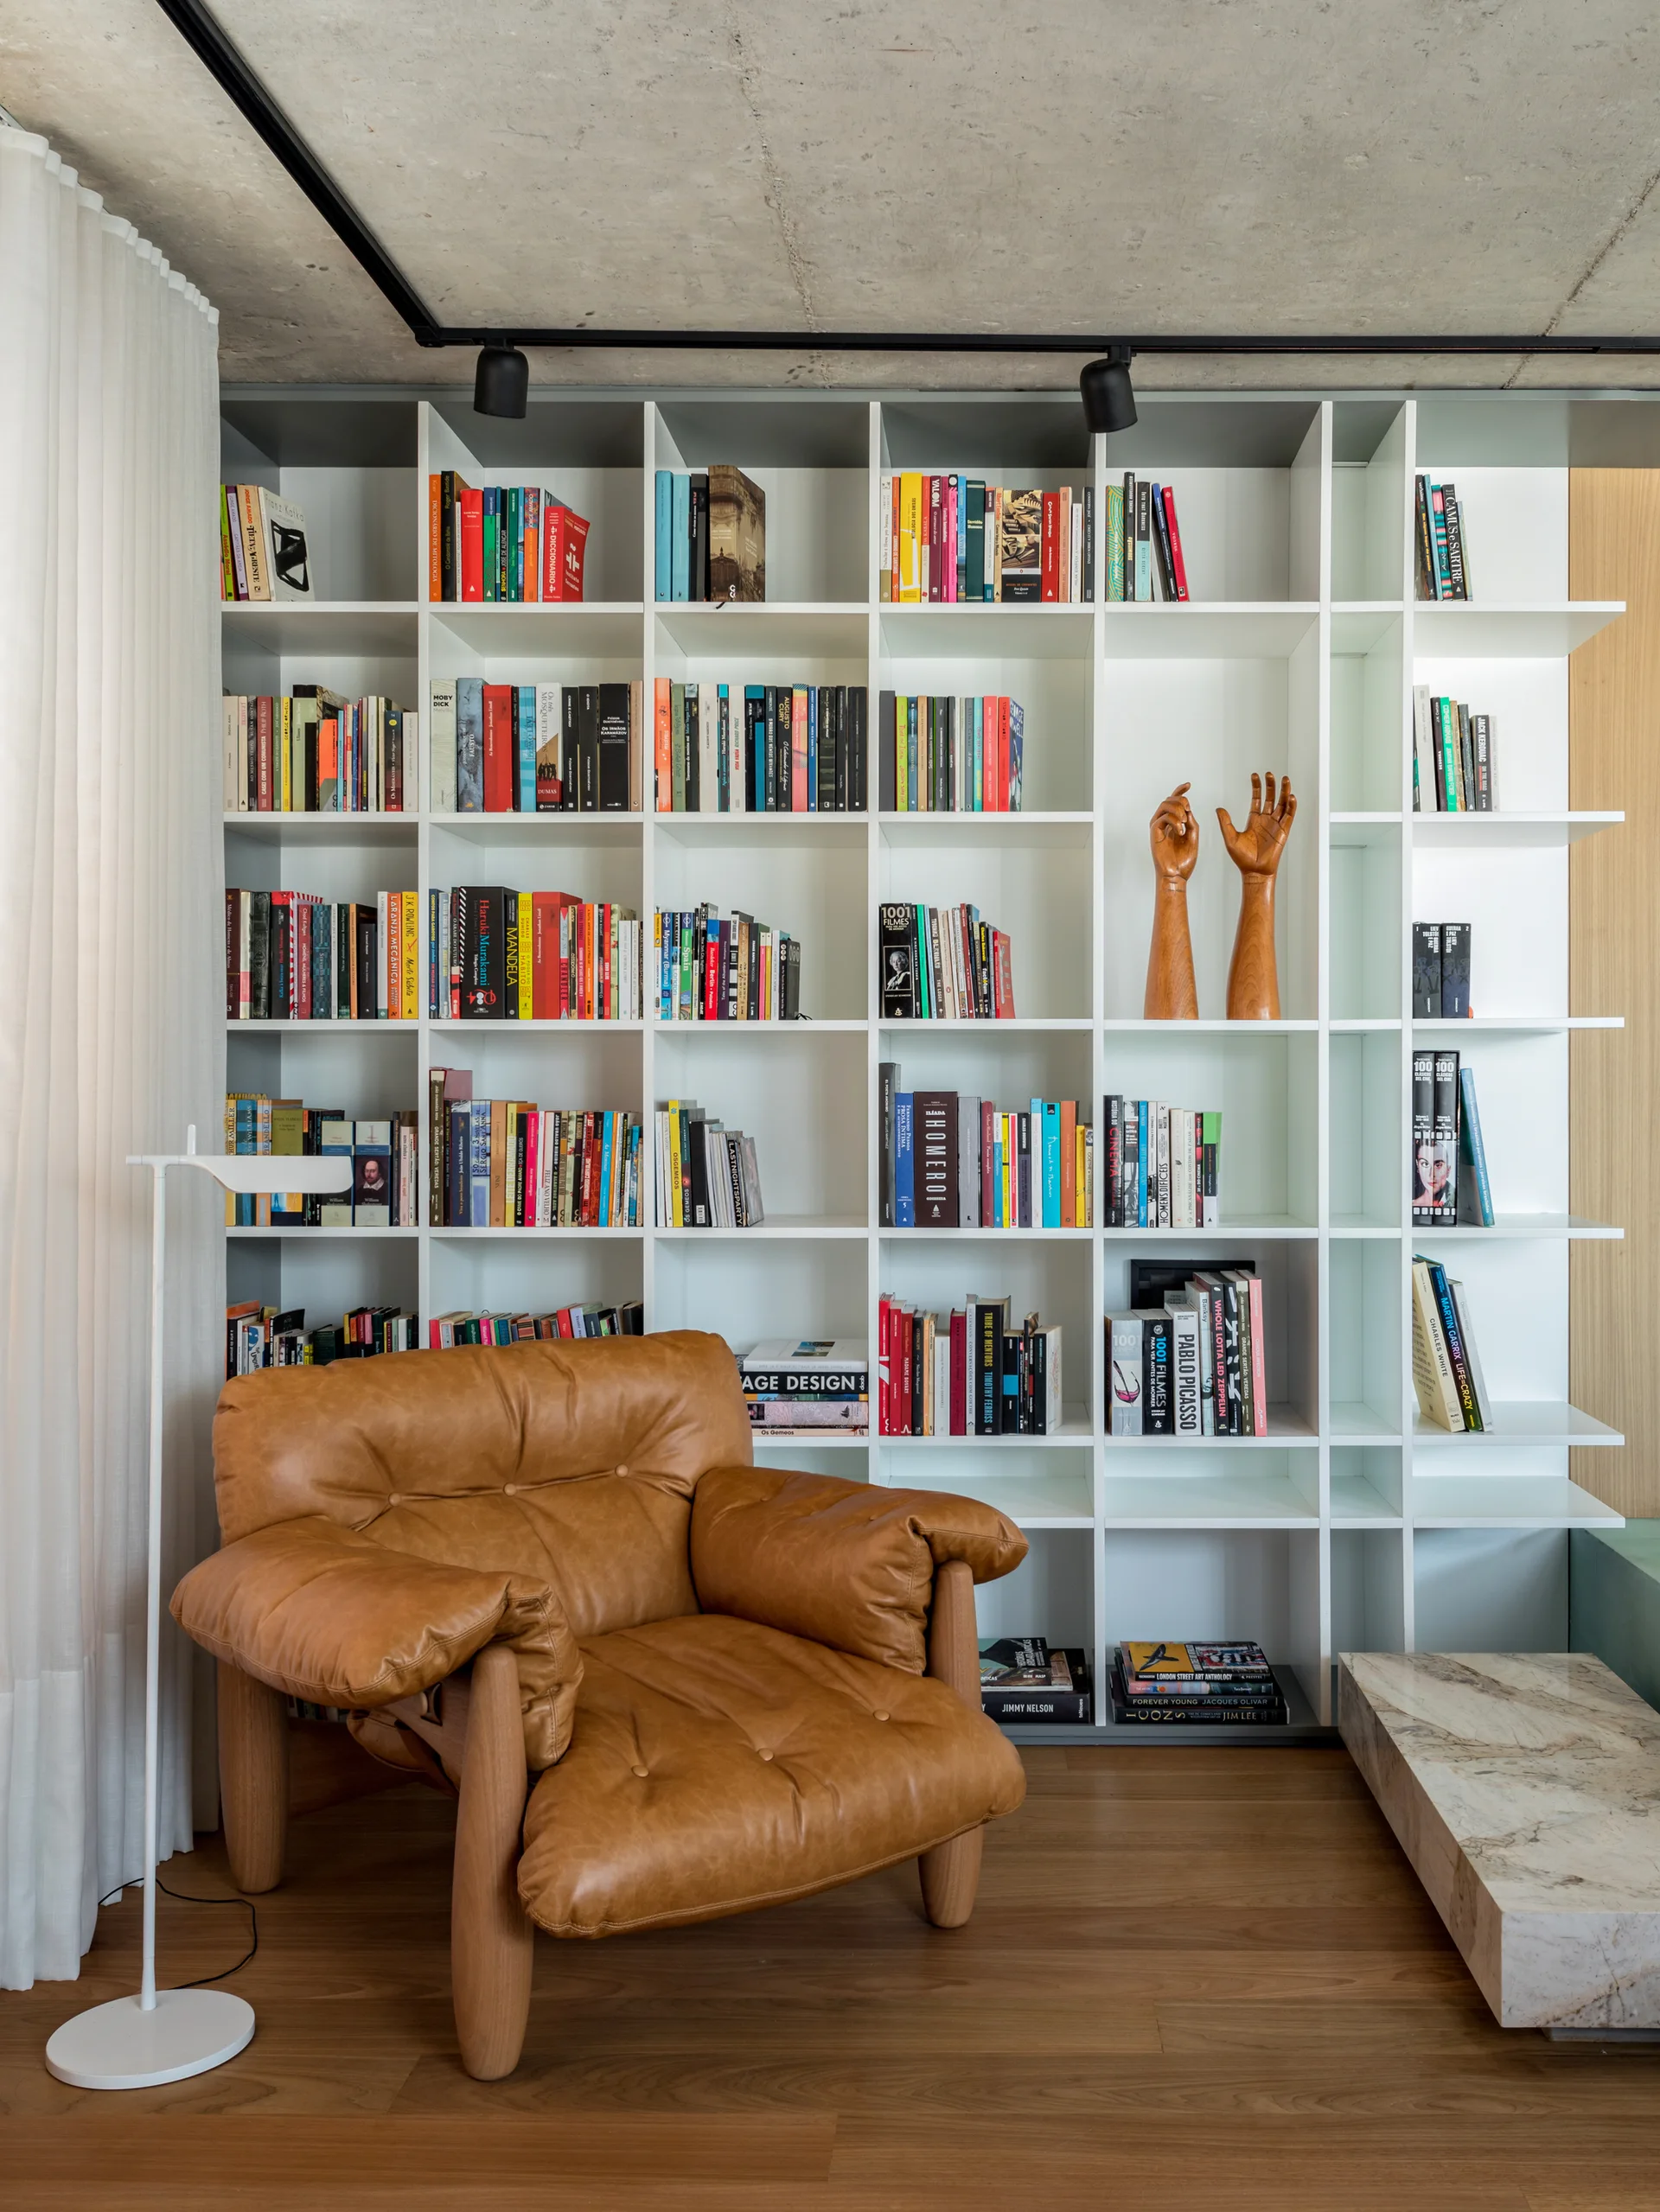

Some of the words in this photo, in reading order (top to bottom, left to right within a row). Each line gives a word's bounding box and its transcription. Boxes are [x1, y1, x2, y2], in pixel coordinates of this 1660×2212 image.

[931, 479, 940, 507] YALOM
[285, 505, 305, 522] Kafka
[1445, 497, 1458, 534] CAMUS
[432, 536, 438, 546] DE
[549, 535, 557, 584] DICCIONARIO
[1450, 542, 1463, 583] SARTRE
[1478, 734, 1486, 762] KEROUAC
[405, 908, 414, 937] ROWLING
[882, 907, 911, 918] 1001
[506, 927, 518, 986] MANDELA
[661, 930, 669, 959] Myanmar
[391, 938, 399, 984] MECÂNICA
[405, 957, 414, 975] Morte
[682, 947, 691, 971] Spain
[405, 977, 414, 996] Súbita
[661, 961, 670, 987] (Burma)
[1414, 1061, 1432, 1072] 100
[1435, 1062, 1454, 1072] 100
[925, 1120, 946, 1192] HOMERO
[1109, 1127, 1119, 1177] CINEMA
[729, 1143, 743, 1224] LASTNIGHTSPARTY
[1159, 1163, 1168, 1192] DIFÍCEIS
[506, 1184, 516, 1203] LEITE
[684, 1214, 690, 1223] OS
[1159, 1193, 1168, 1223] HOMENS
[984, 1312, 993, 1330] TRIBE
[1440, 1297, 1455, 1329] MARTIN
[1448, 1331, 1461, 1359] GARRIX
[984, 1339, 993, 1367] MENTORS
[1156, 1337, 1166, 1362] 1001
[1178, 1334, 1195, 1373] PABLO
[1429, 1318, 1442, 1352] CHARLES
[1438, 1354, 1448, 1377] WHITE
[787, 1375, 855, 1390] DESIGN
[984, 1372, 993, 1398] TIMOTHY
[1156, 1365, 1166, 1407] FILMES
[984, 1399, 993, 1423] FERRISS
[1179, 1376, 1196, 1430] PICASSO
[1218, 1378, 1226, 1417] ZEPPELIN
[1002, 1704, 1025, 1712] JIMMY
[1026, 1704, 1053, 1712] NELSON
[1223, 1711, 1238, 1721] JIM
[1241, 1711, 1257, 1721] LEE
